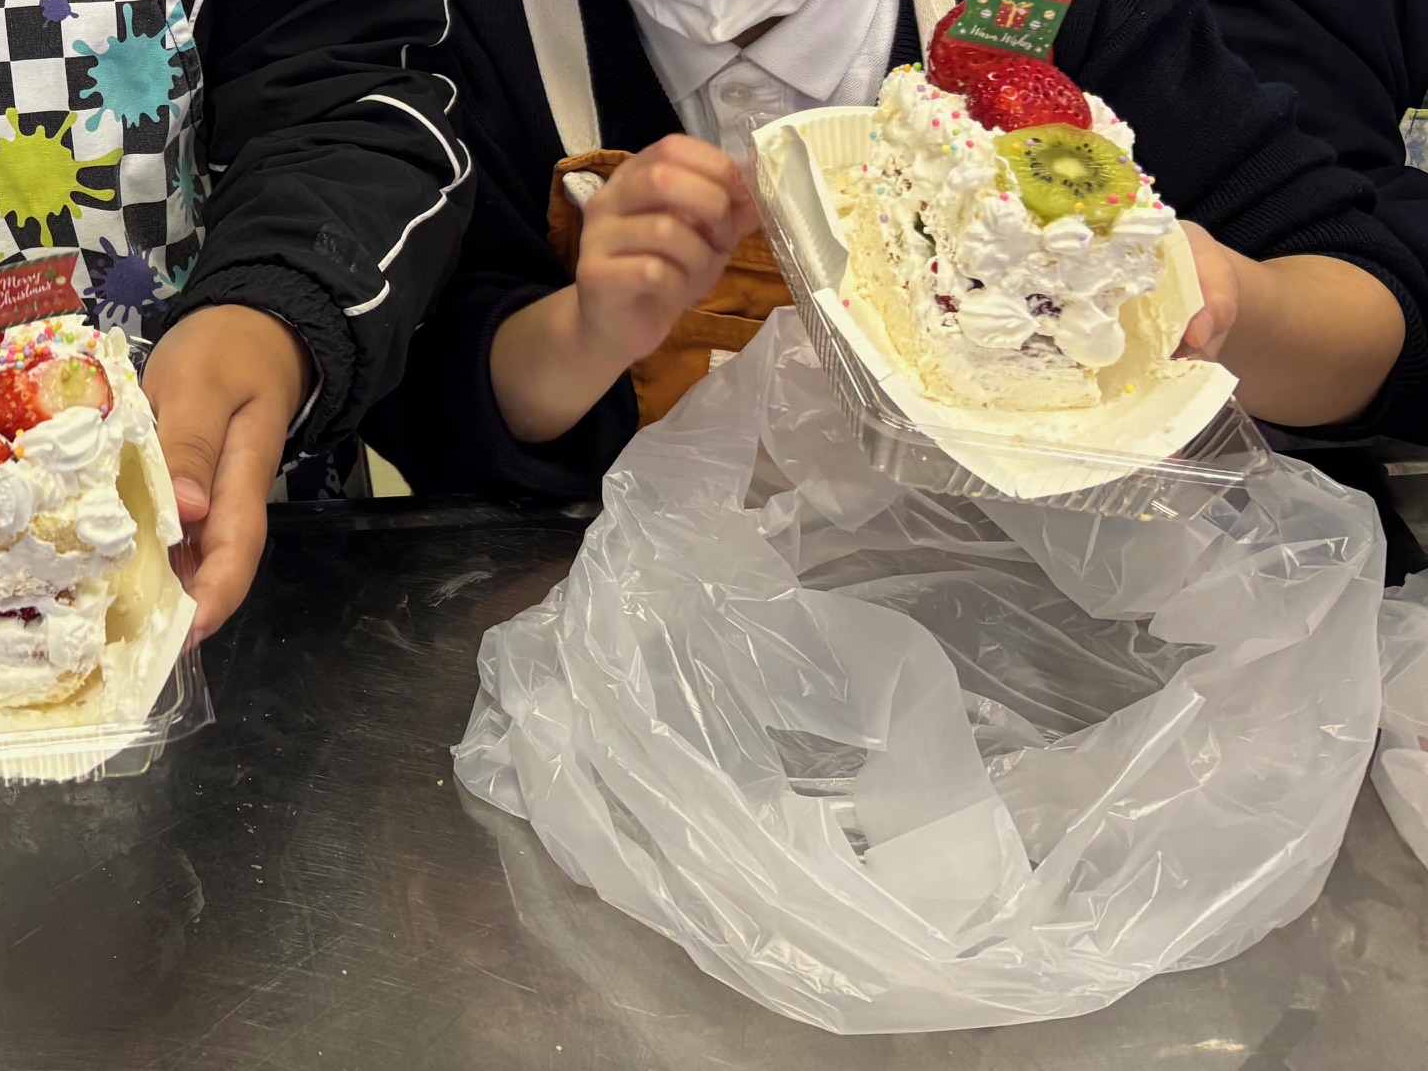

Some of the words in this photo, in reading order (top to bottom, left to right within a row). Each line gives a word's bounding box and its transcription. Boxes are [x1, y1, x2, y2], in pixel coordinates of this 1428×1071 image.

[969, 24, 998, 41] Warm
[1000, 33, 1033, 50] Wishes
[0, 272, 41, 291] Merry
